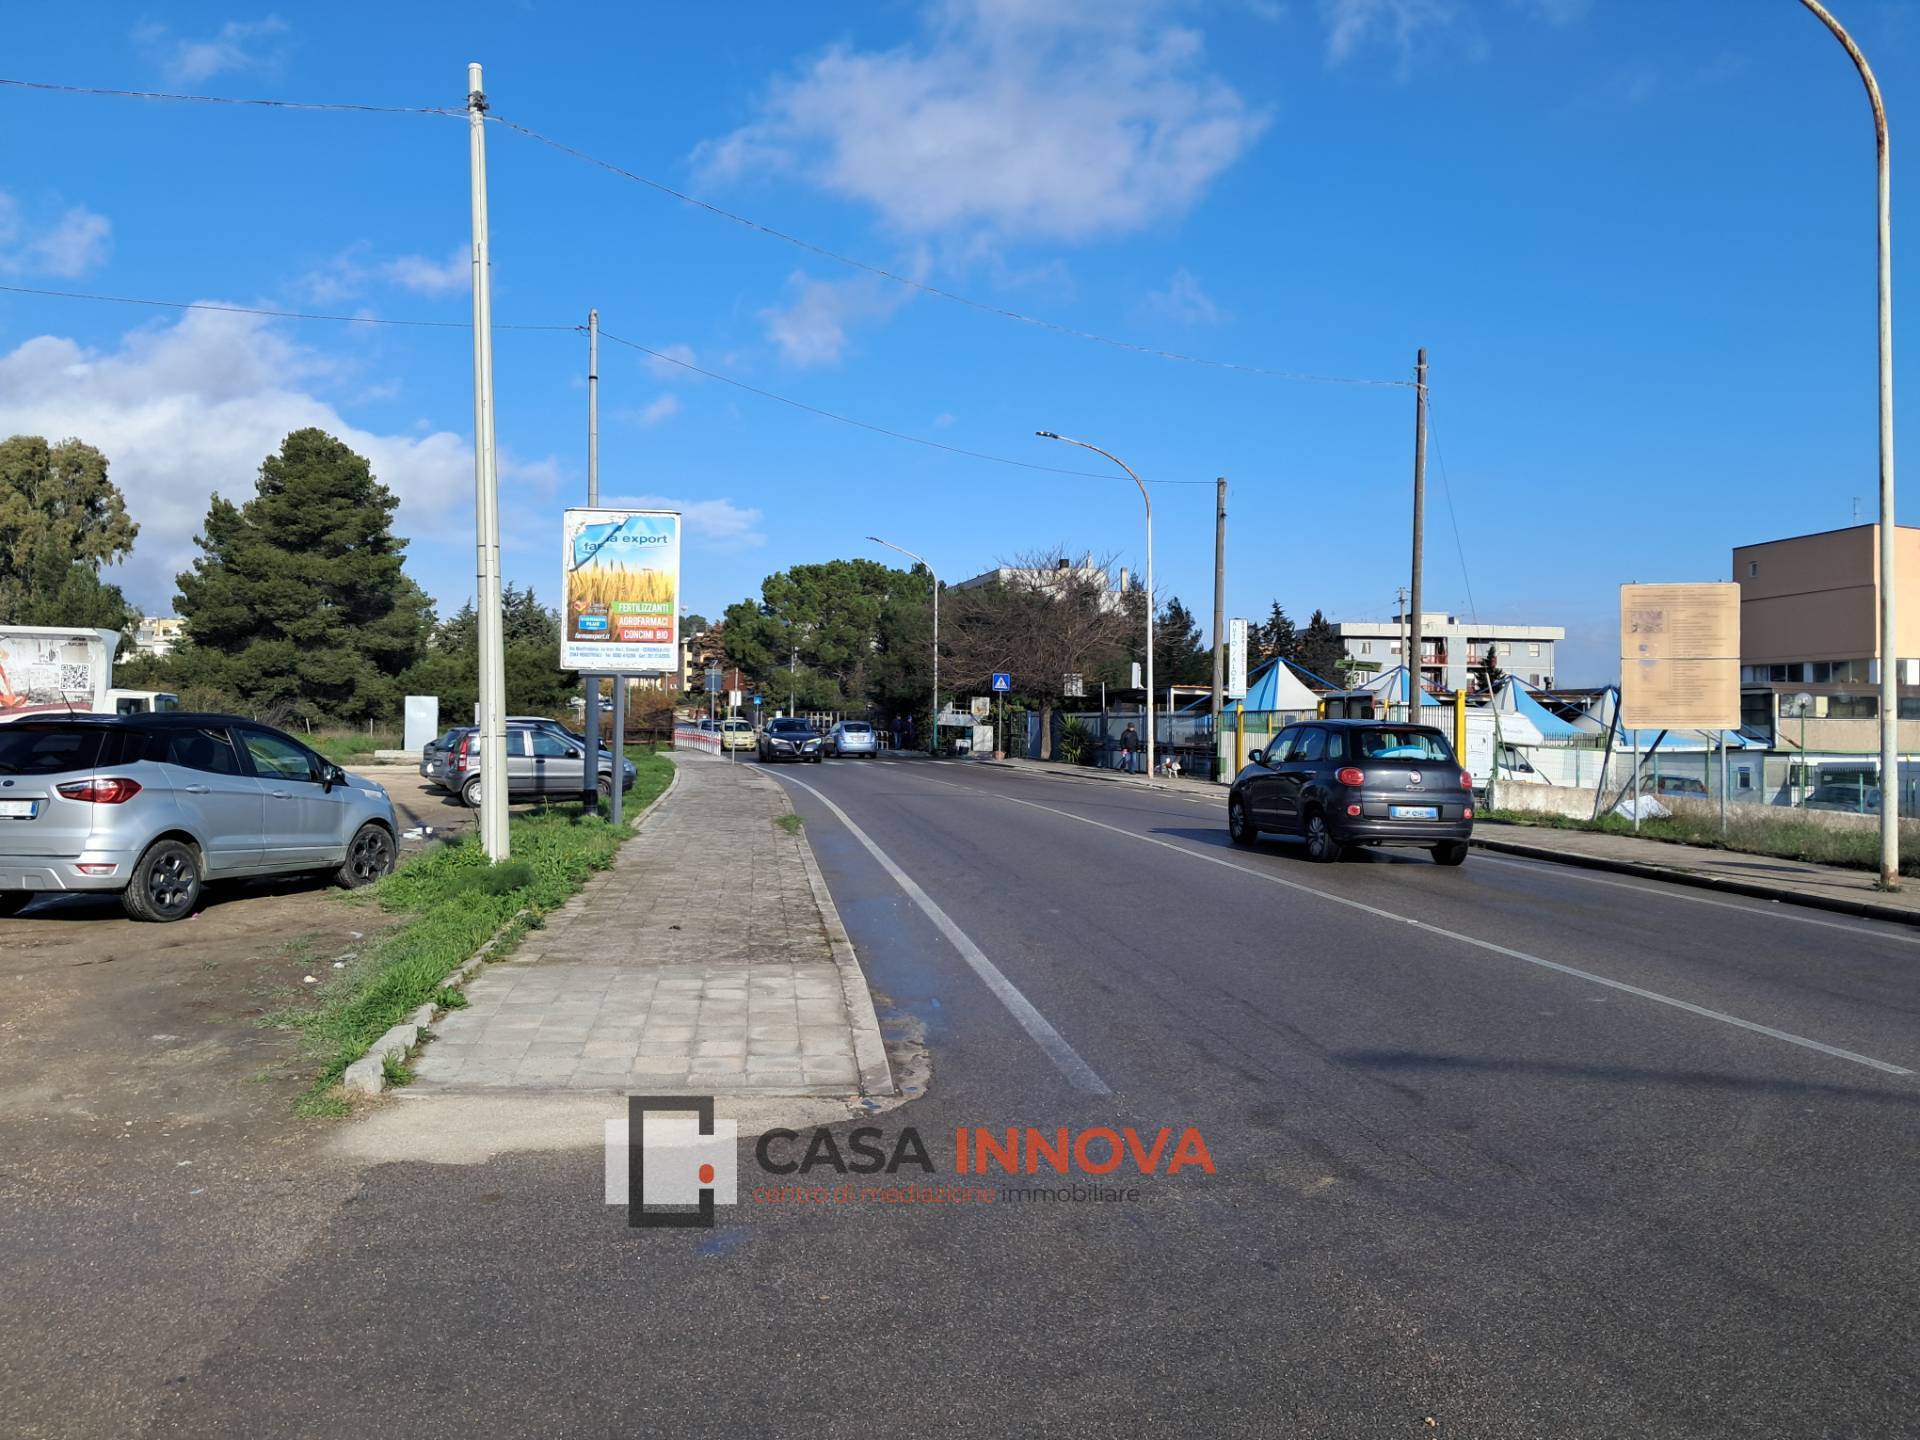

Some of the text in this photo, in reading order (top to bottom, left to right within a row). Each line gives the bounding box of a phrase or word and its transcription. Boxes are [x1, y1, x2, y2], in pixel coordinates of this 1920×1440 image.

[622, 535, 668, 545] export
[620, 602, 669, 613] FERTILIZZANTI
[618, 615, 669, 627] AGROFARMACI
[623, 629, 669, 640] CONCIMI BIO
